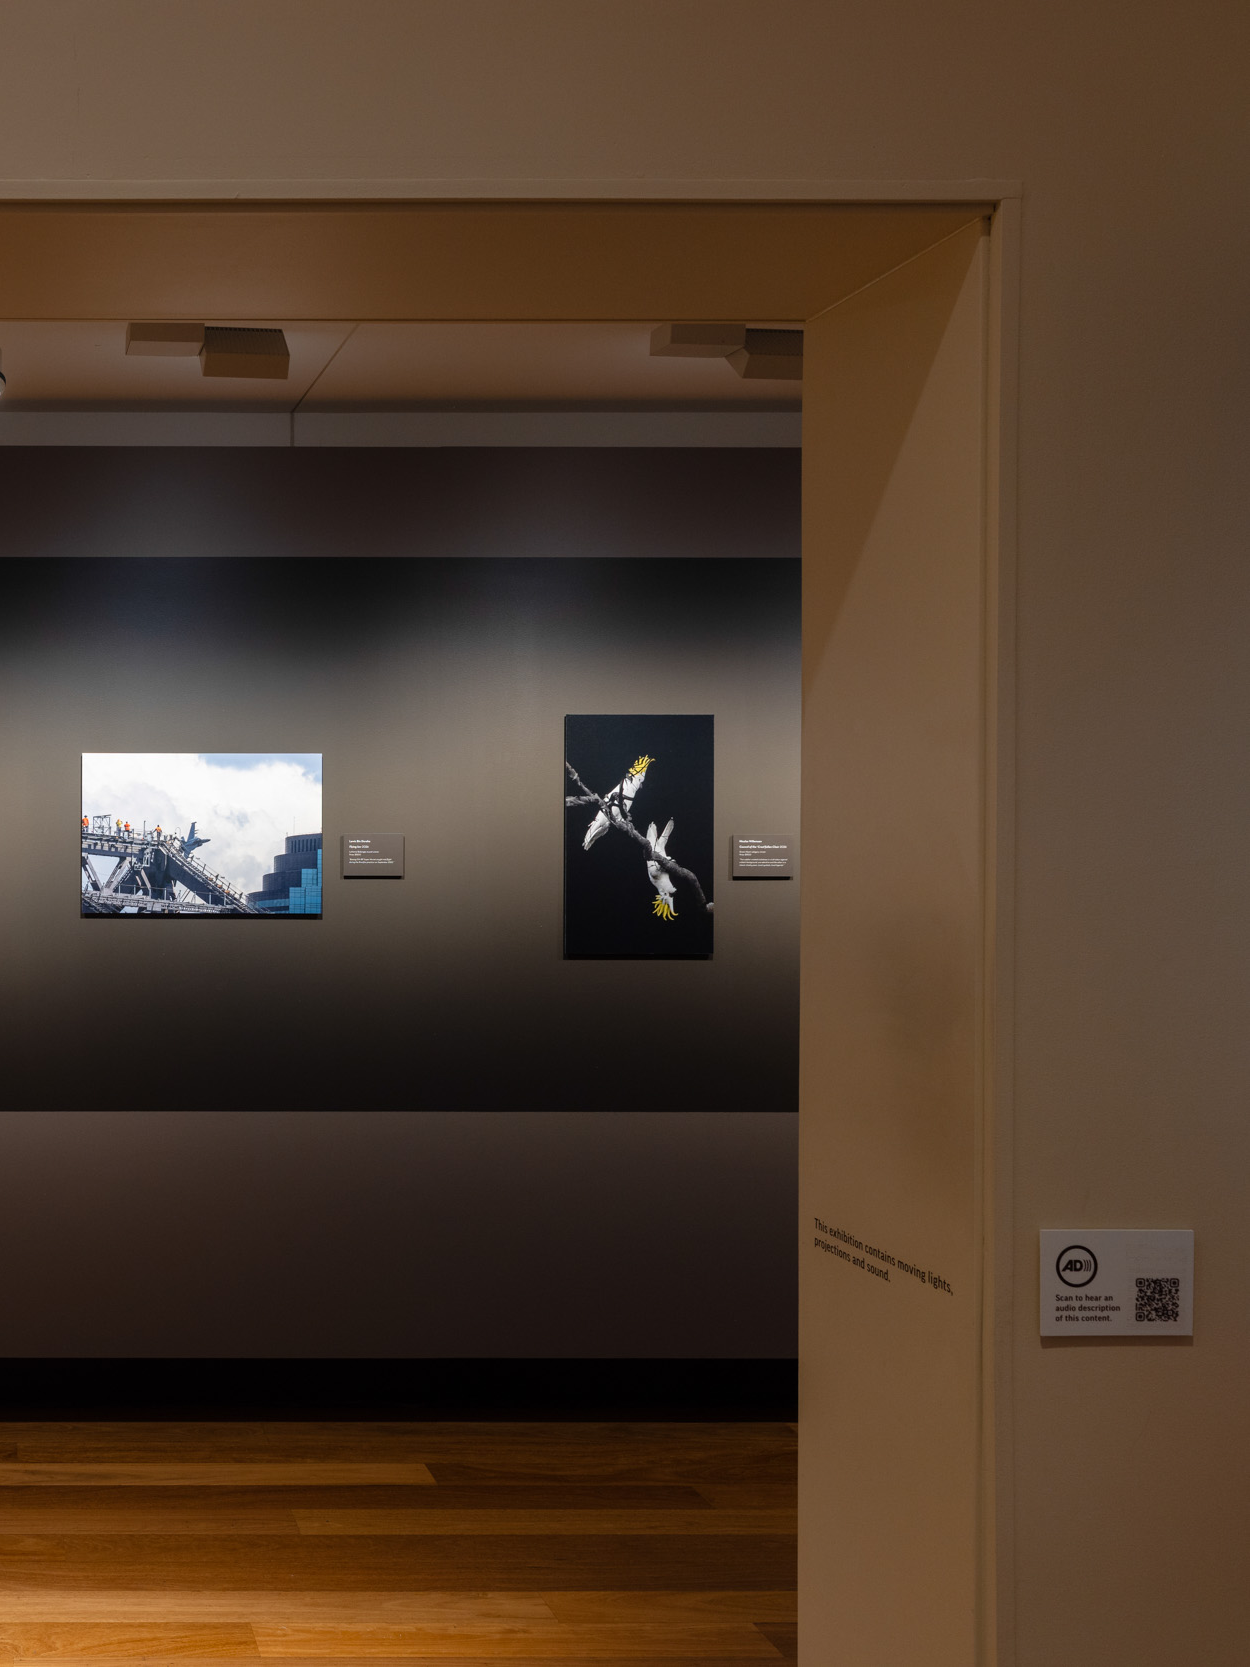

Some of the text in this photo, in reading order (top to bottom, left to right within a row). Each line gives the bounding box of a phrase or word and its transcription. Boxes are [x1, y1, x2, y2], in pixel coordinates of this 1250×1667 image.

[814, 1217, 954, 1296] This exhibition contains moving lights,
[814, 1236, 891, 1283] projections and sound.
[1055, 1294, 1074, 1302] Scan
[1075, 1294, 1083, 1302] to
[1085, 1294, 1102, 1302] hear
[1055, 1304, 1121, 1313] audio description
[1055, 1314, 1113, 1322] of this content.
